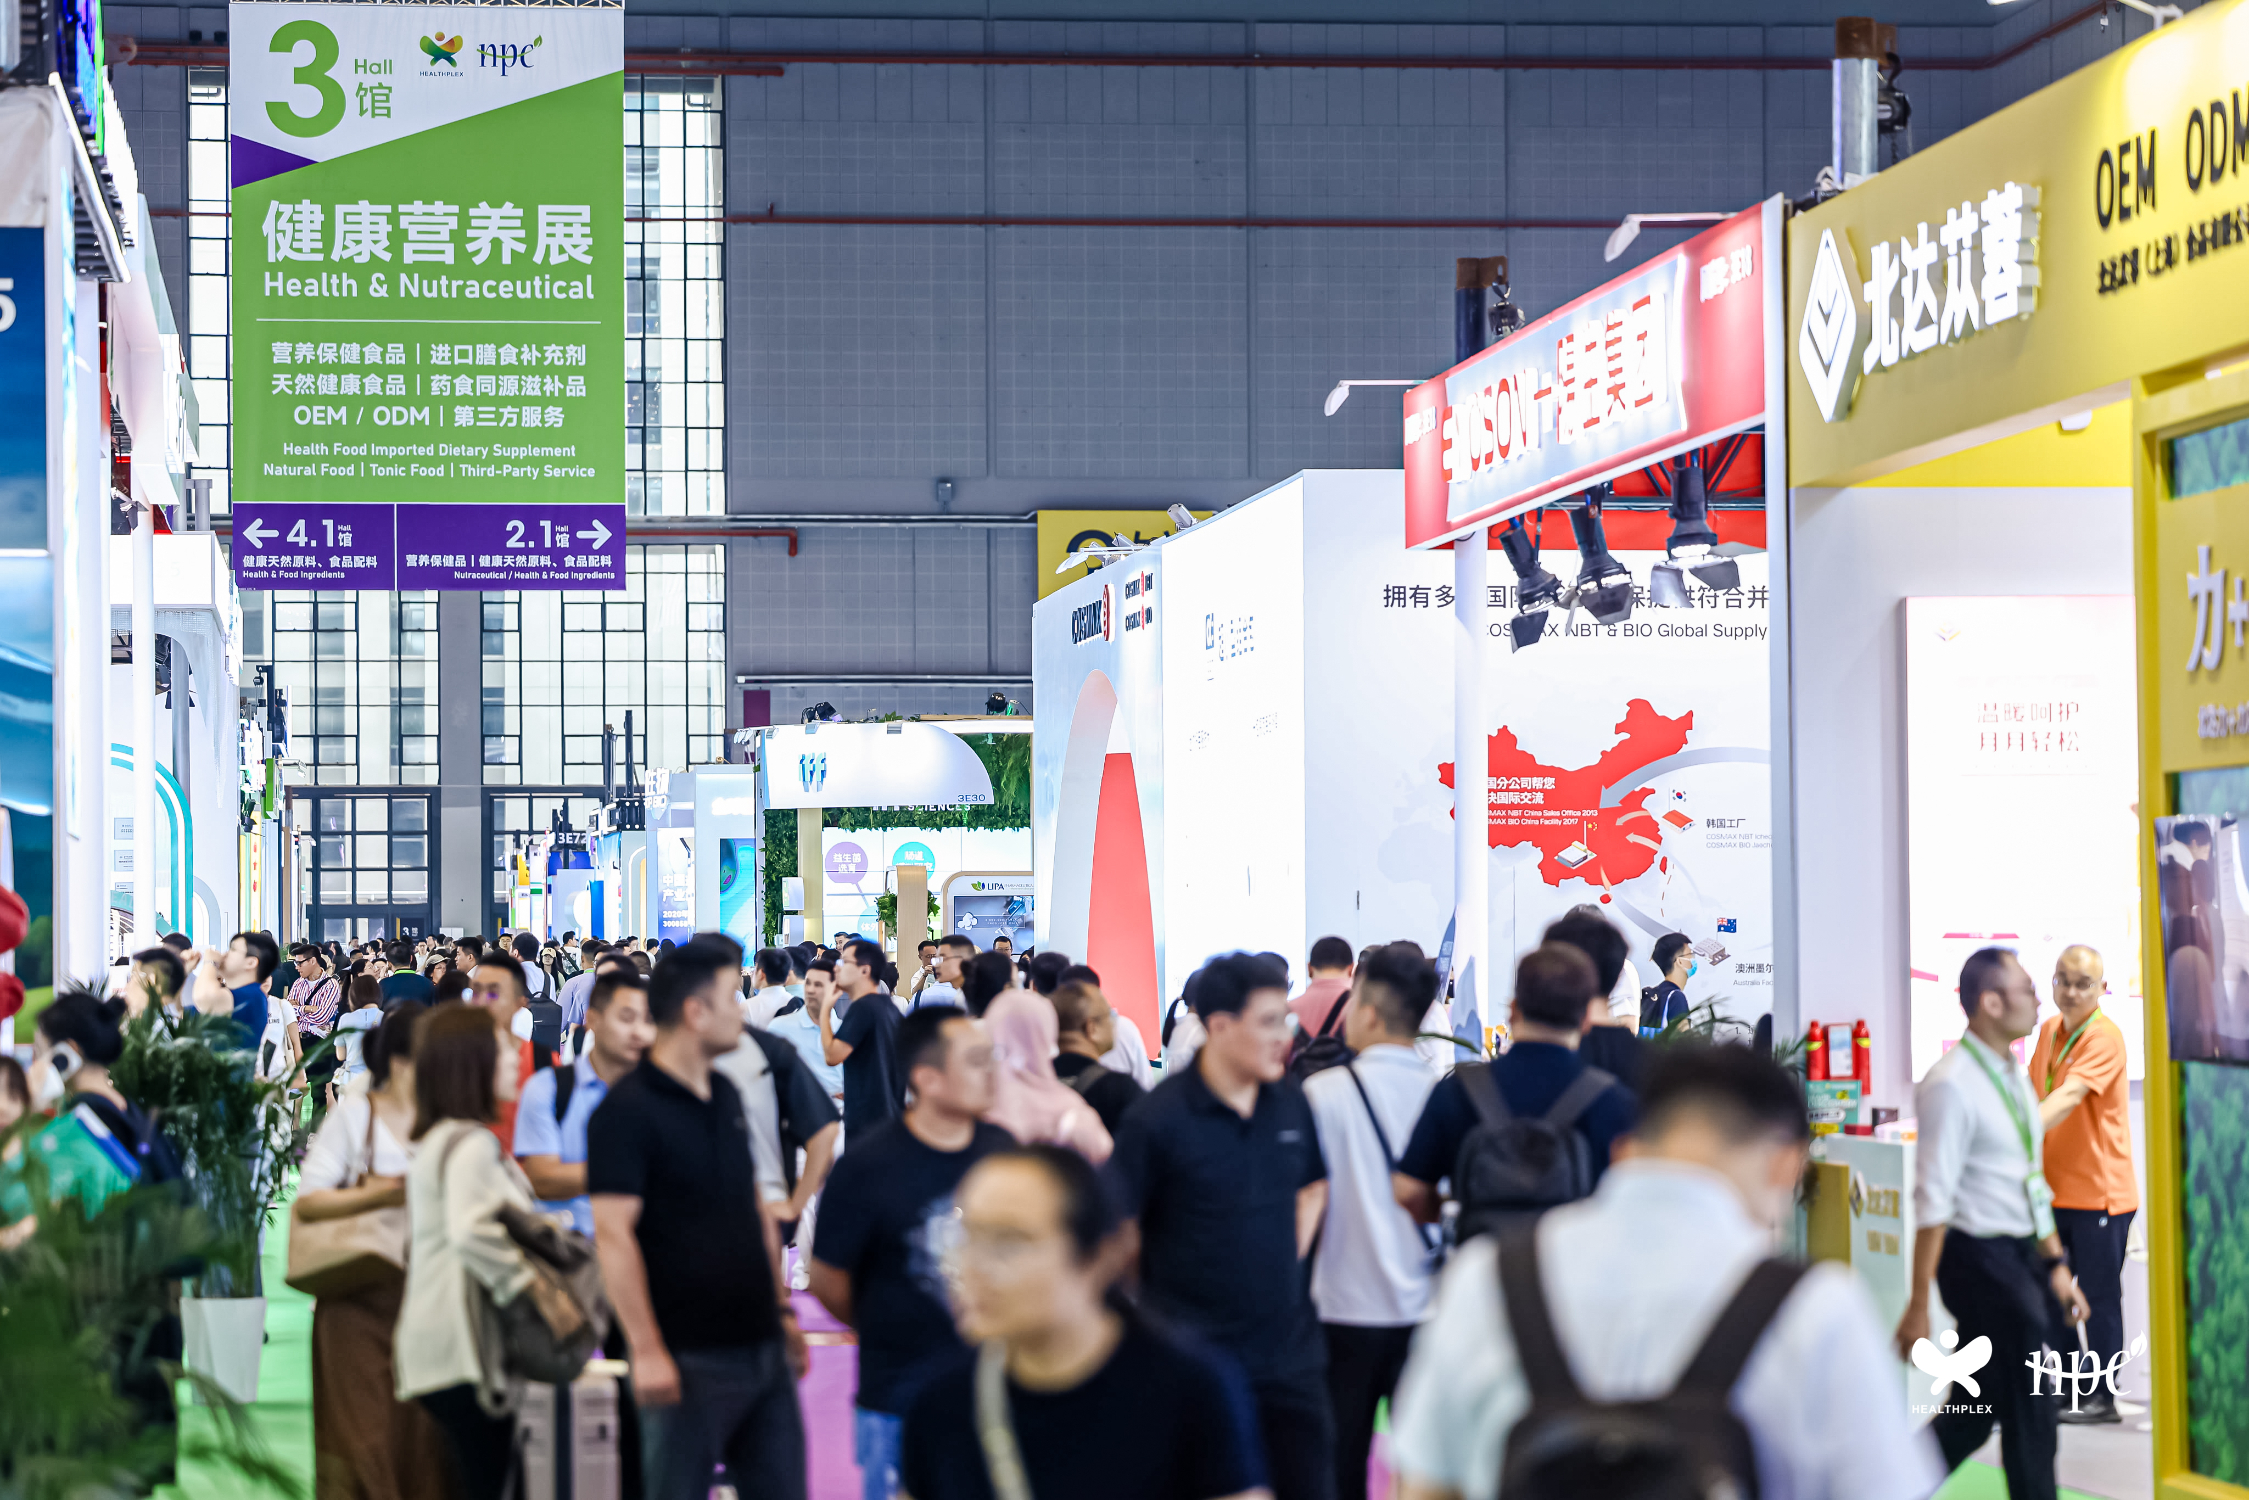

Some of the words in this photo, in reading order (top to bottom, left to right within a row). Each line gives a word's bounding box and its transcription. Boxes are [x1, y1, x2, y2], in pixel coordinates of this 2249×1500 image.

[355, 59, 393, 75] Hall
[478, 43, 535, 77] npc
[265, 20, 346, 138] 3
[355, 82, 393, 118] 馆
[2097, 129, 2157, 230] OEM
[262, 199, 593, 265] 健康营养展
[264, 272, 358, 297] Health
[368, 272, 389, 297] &
[399, 273, 595, 299] Nutraceutical
[271, 342, 406, 365] 营养保健食品
[430, 343, 587, 366] 进口膳食补充剂
[271, 373, 406, 396] 天然健康食品
[430, 374, 587, 397] 药食同源滋补品
[294, 405, 347, 425] OEM
[373, 405, 430, 425] ODM
[453, 405, 565, 428] 第三方服务
[283, 442, 328, 456] Health
[333, 442, 367, 456] Food
[371, 442, 434, 459] Imported
[439, 443, 489, 459] Dietary
[492, 443, 576, 460] Supplement
[264, 463, 316, 476] Natural
[321, 463, 355, 476] Food
[370, 463, 406, 476] Tonic
[410, 463, 445, 477] Food
[459, 463, 539, 479] Third-Party
[543, 464, 596, 477] Service
[286, 519, 333, 547] 4.1
[338, 532, 352, 547] 馆
[505, 519, 551, 548] 2.1
[556, 533, 570, 548] 馆
[242, 555, 378, 568] 健康天然原料、食品配料
[406, 554, 467, 567] 营养保健品
[479, 554, 612, 568] 健康天然原料、食品配料
[243, 570, 269, 578] Health
[271, 570, 277, 578] &
[279, 570, 298, 578] Food
[300, 570, 345, 580] Ingredients
[454, 571, 506, 579] Nutraceutical
[514, 571, 540, 579] Health
[542, 571, 548, 579] &
[550, 571, 569, 579] Food
[571, 571, 615, 580] Ingredients
[1624, 624, 1652, 637] BIO
[1658, 623, 1708, 637] Global
[1713, 623, 1768, 640] Supply
[957, 794, 986, 802] 3E30
[1540, 818, 1561, 826] Facility
[1706, 818, 1746, 828] 韩国工厂
[558, 832, 587, 844] 3E72
